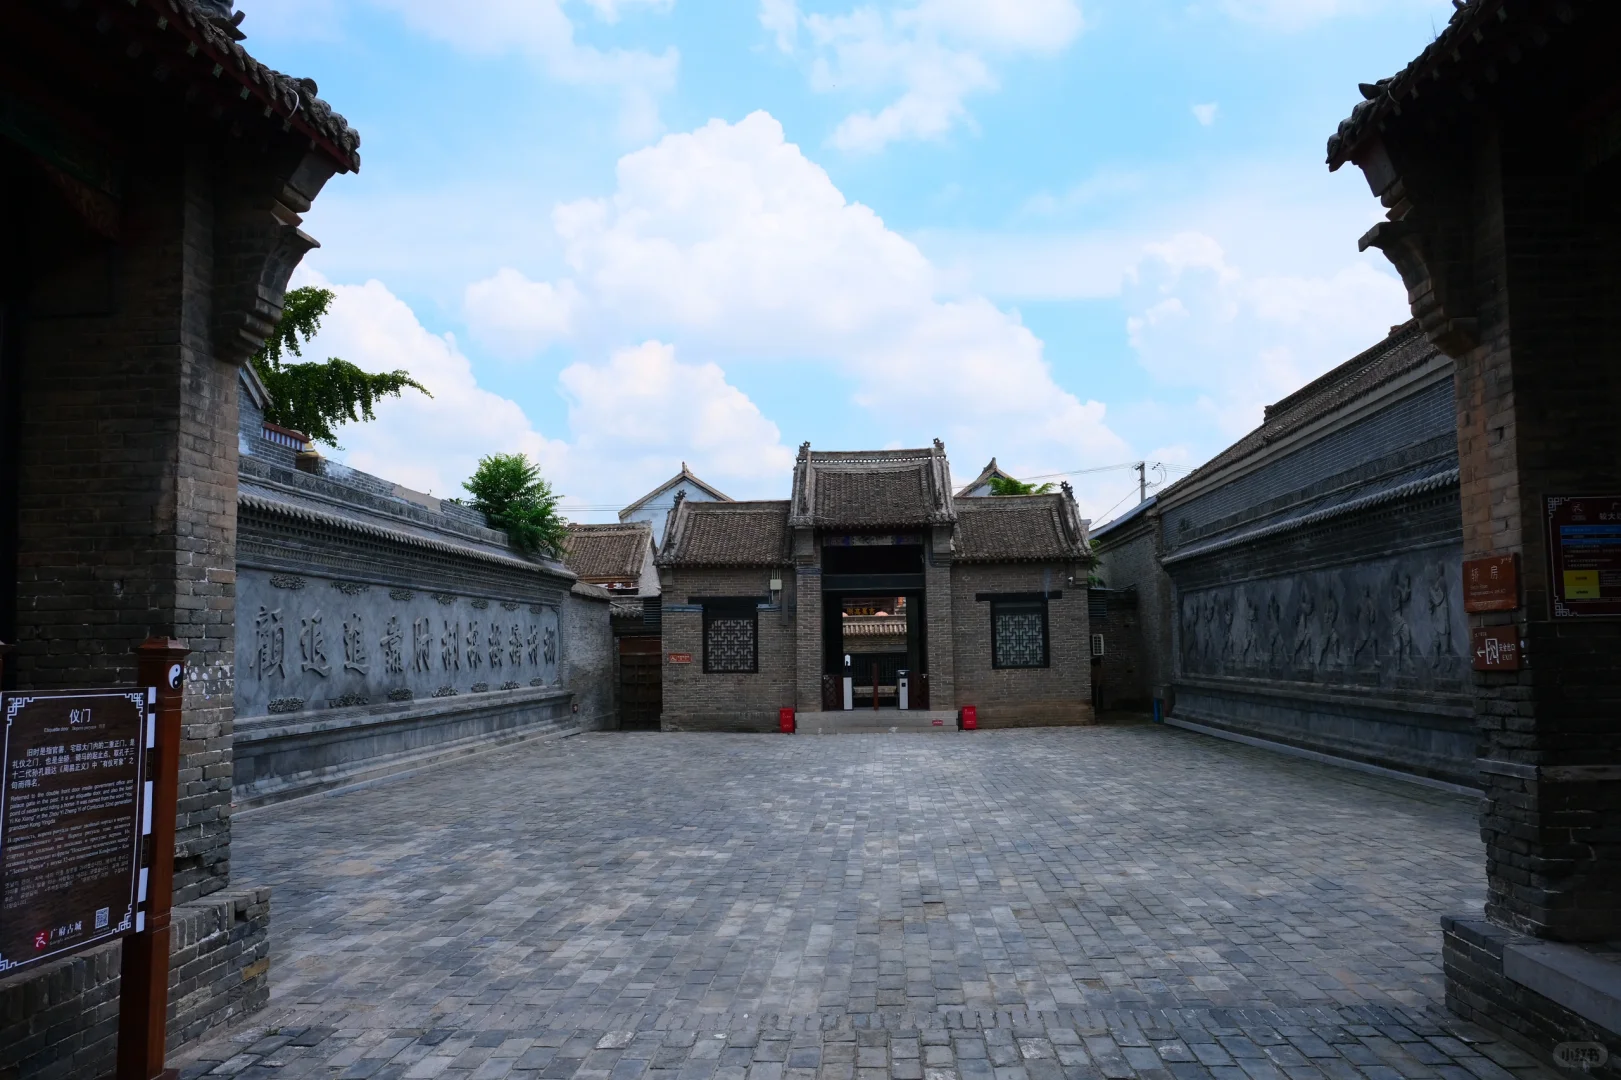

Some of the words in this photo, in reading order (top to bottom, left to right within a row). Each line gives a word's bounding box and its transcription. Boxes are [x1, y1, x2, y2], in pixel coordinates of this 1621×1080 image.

[1498, 642, 1516, 652] 安全出口
[69, 708, 91, 724] 仪门
